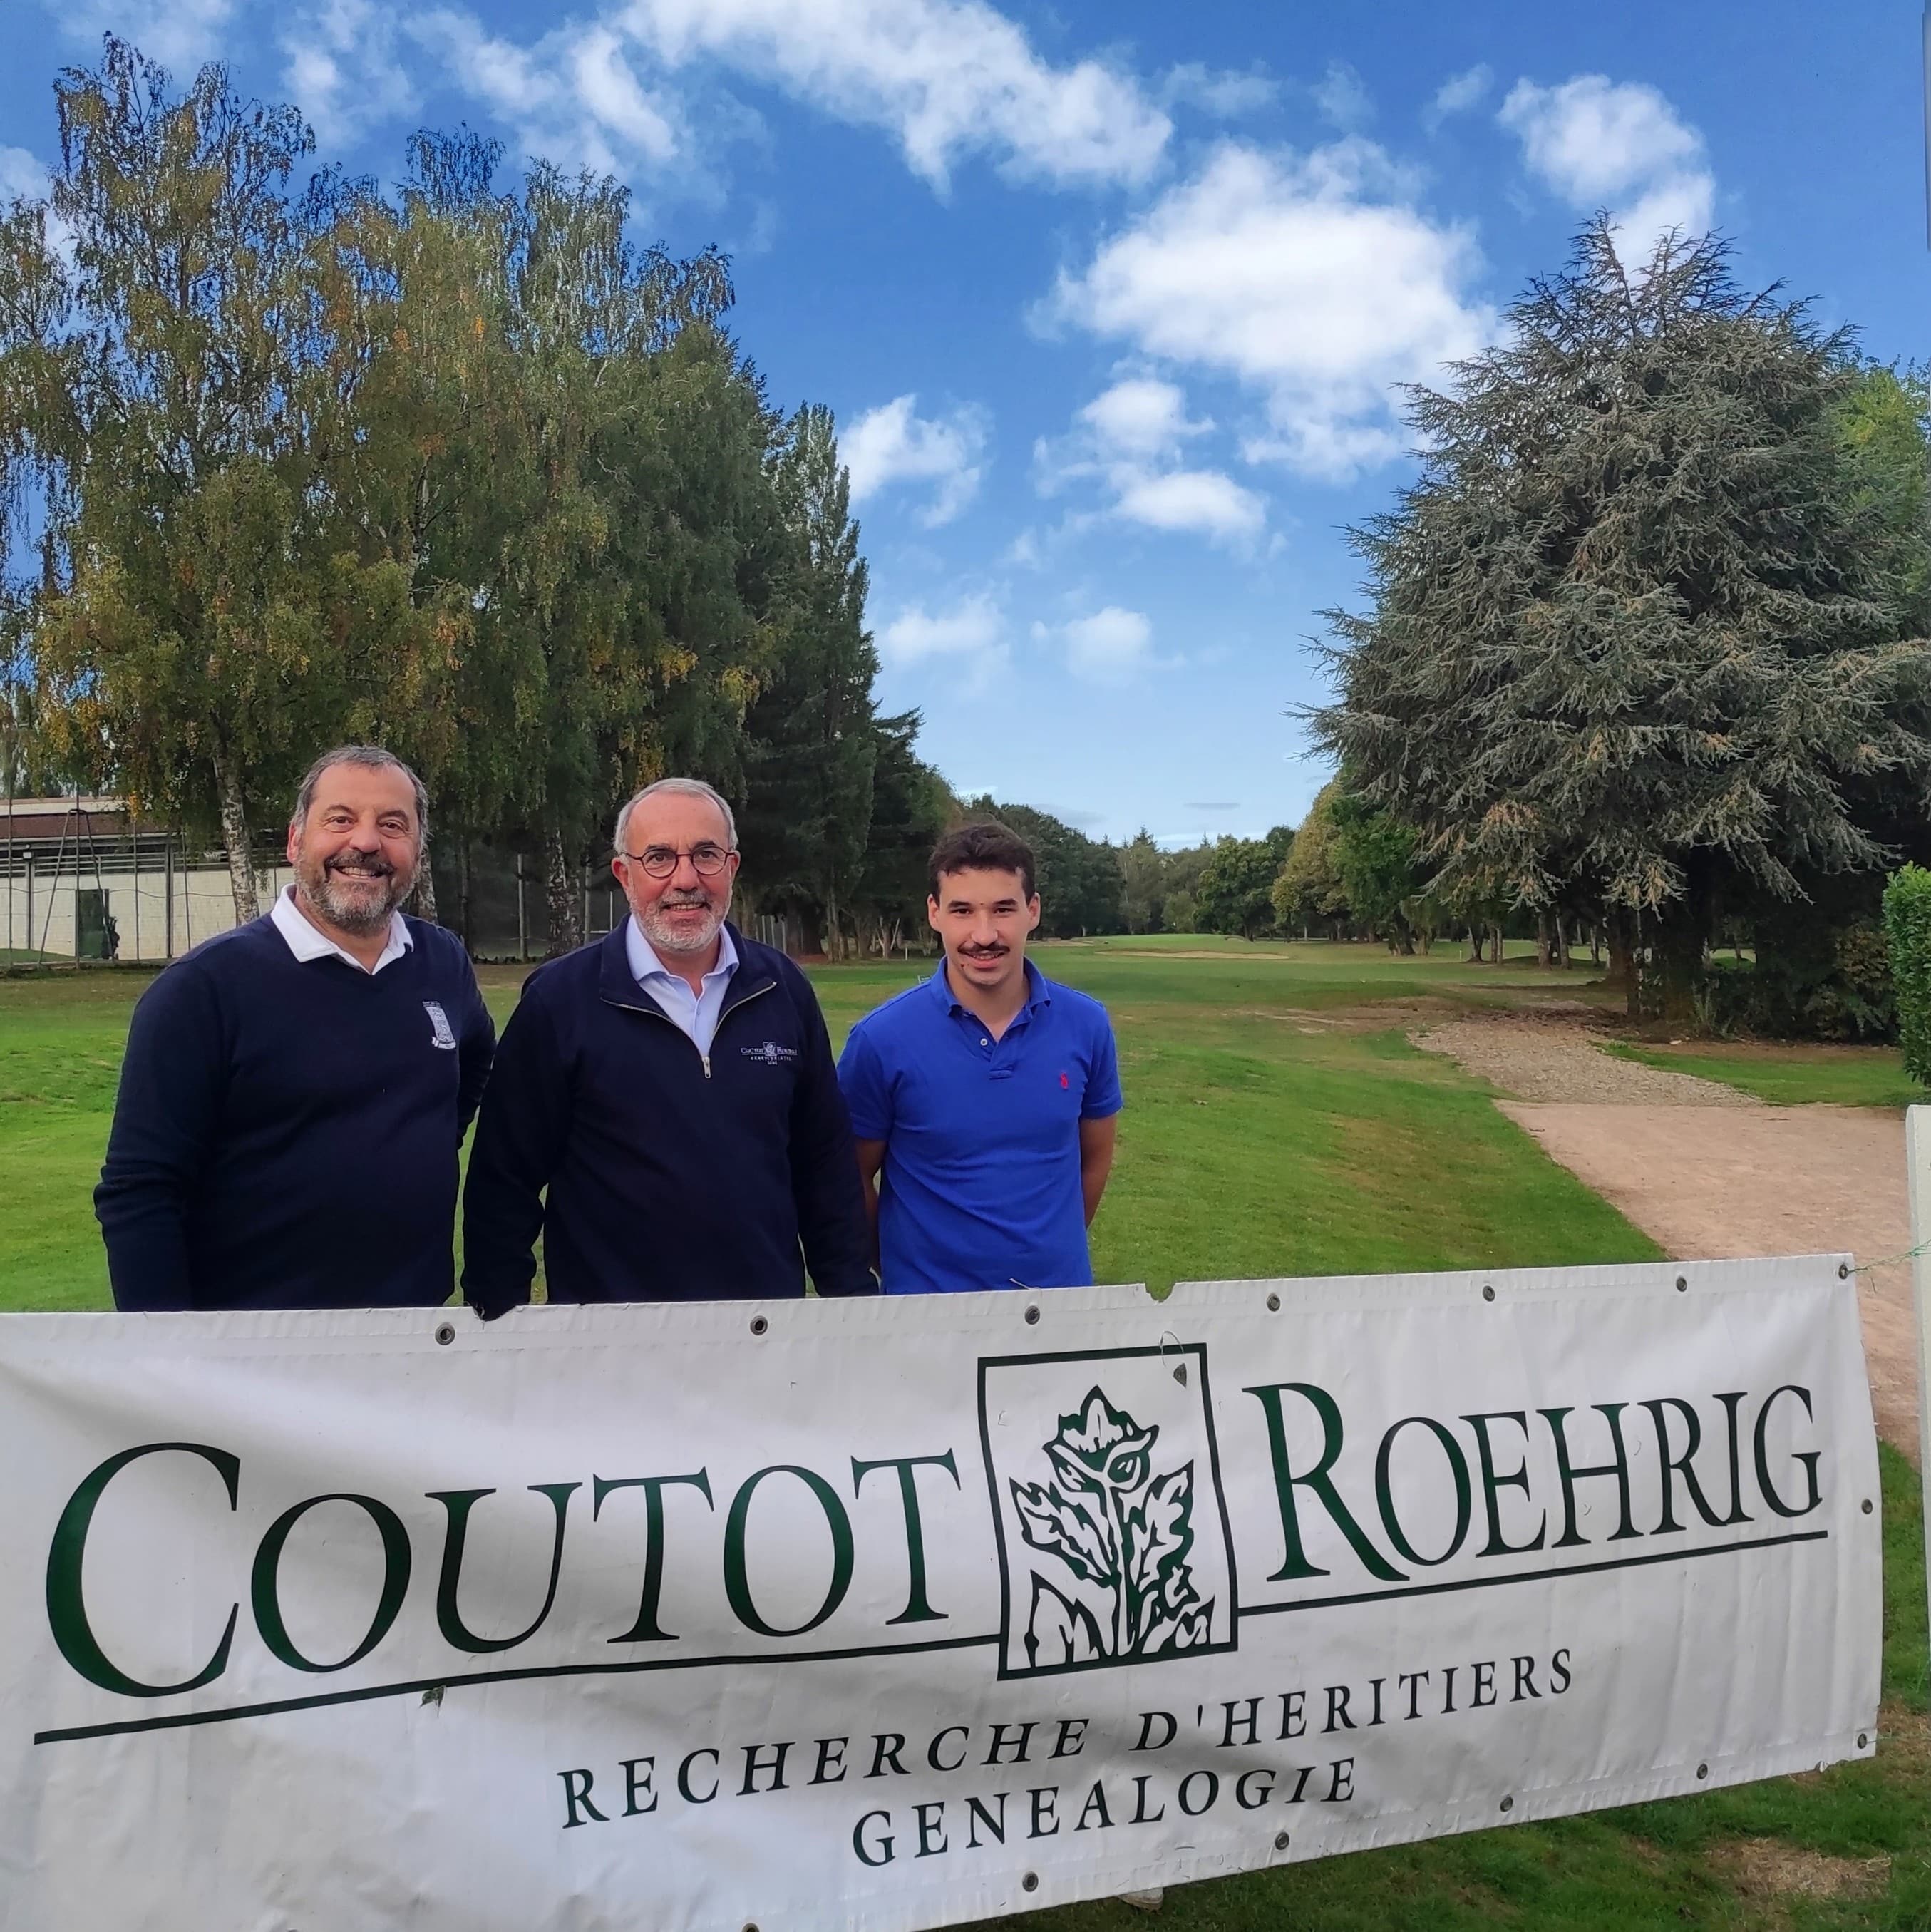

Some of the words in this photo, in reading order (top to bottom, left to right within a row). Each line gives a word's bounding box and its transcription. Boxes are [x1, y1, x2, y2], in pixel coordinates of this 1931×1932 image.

[46, 1442, 962, 1698] COUTOT
[1241, 1383, 1823, 1582] ROEHRIG
[557, 1718, 1090, 1830] RECHERCHE
[1128, 1648, 1572, 1752] D'HERITIERS
[853, 1757, 1356, 1867] GENEALOGIE
